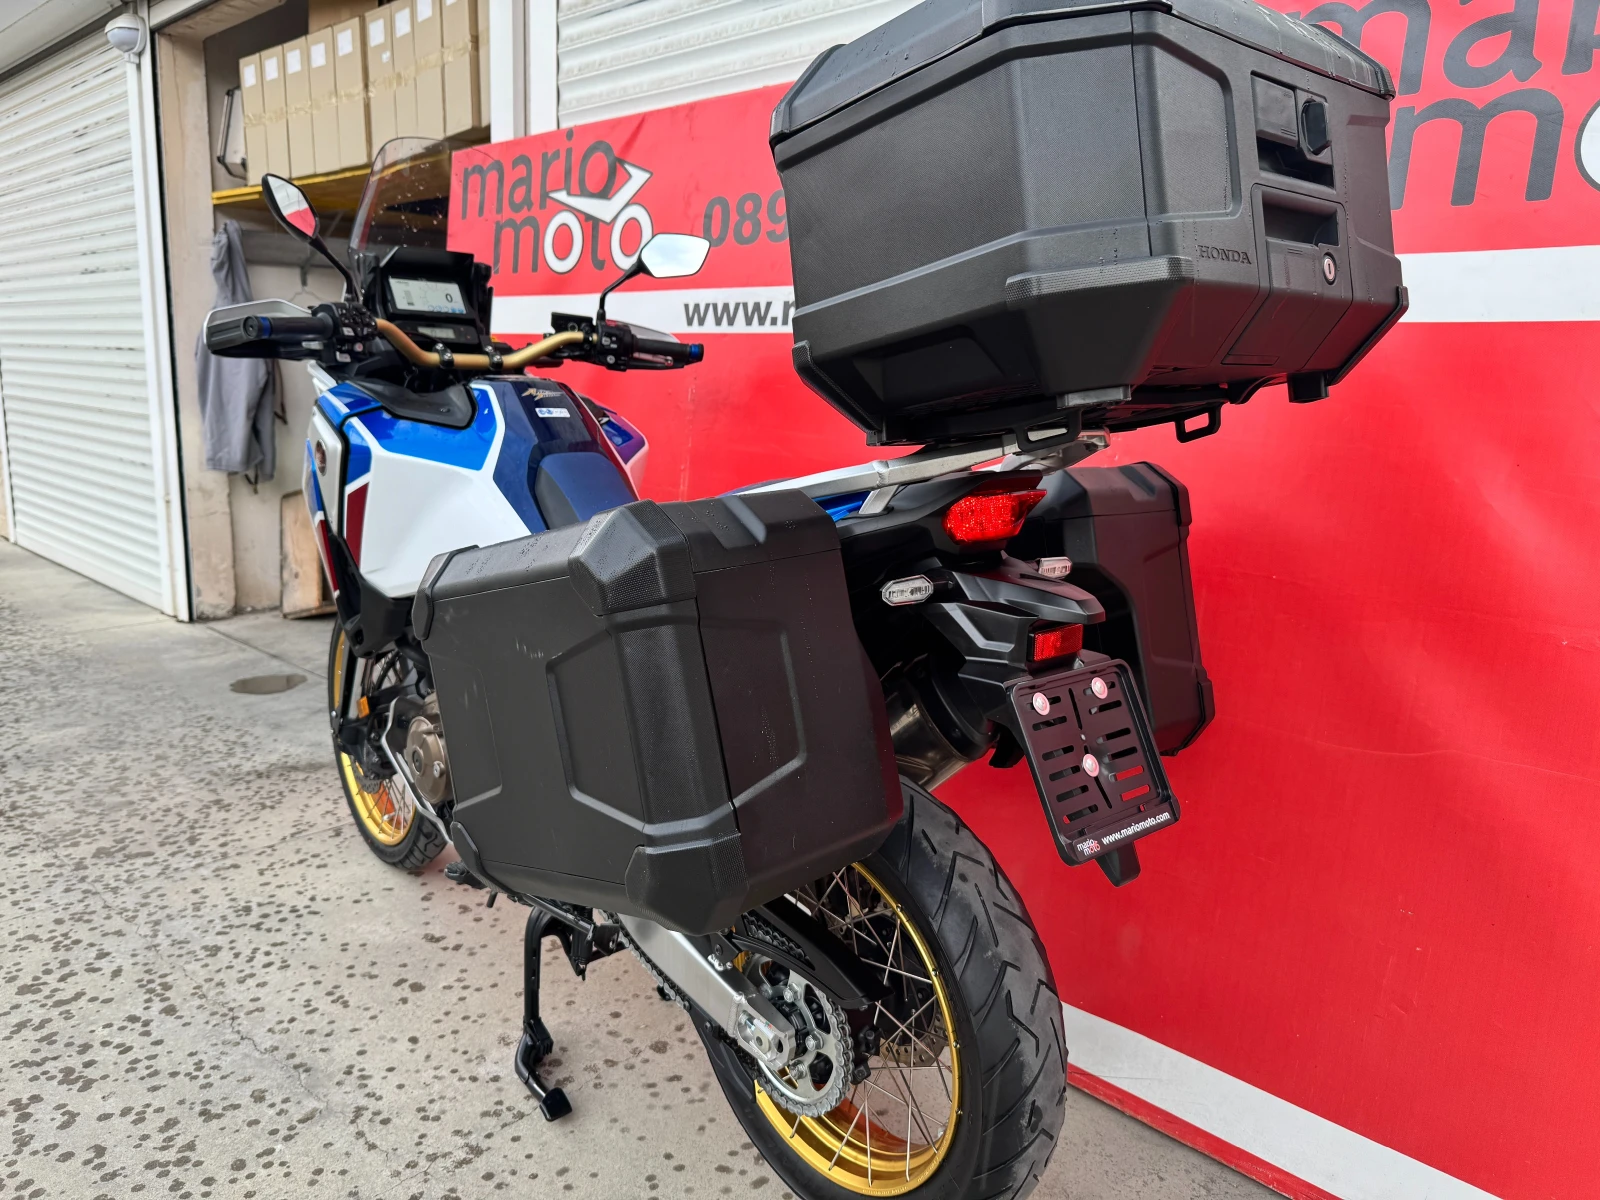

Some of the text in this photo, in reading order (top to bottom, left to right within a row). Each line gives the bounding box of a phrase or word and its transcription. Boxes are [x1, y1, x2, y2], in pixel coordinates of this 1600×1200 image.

[1388, 88, 1600, 210] m
[462, 129, 618, 220] mario
[493, 203, 654, 275] moto
[702, 189, 789, 247] 089
[1197, 244, 1252, 265] HONDA
[1077, 838, 1095, 852] mario
[1084, 842, 1101, 856] moto
[1101, 811, 1171, 845] www.mariomoto.com
